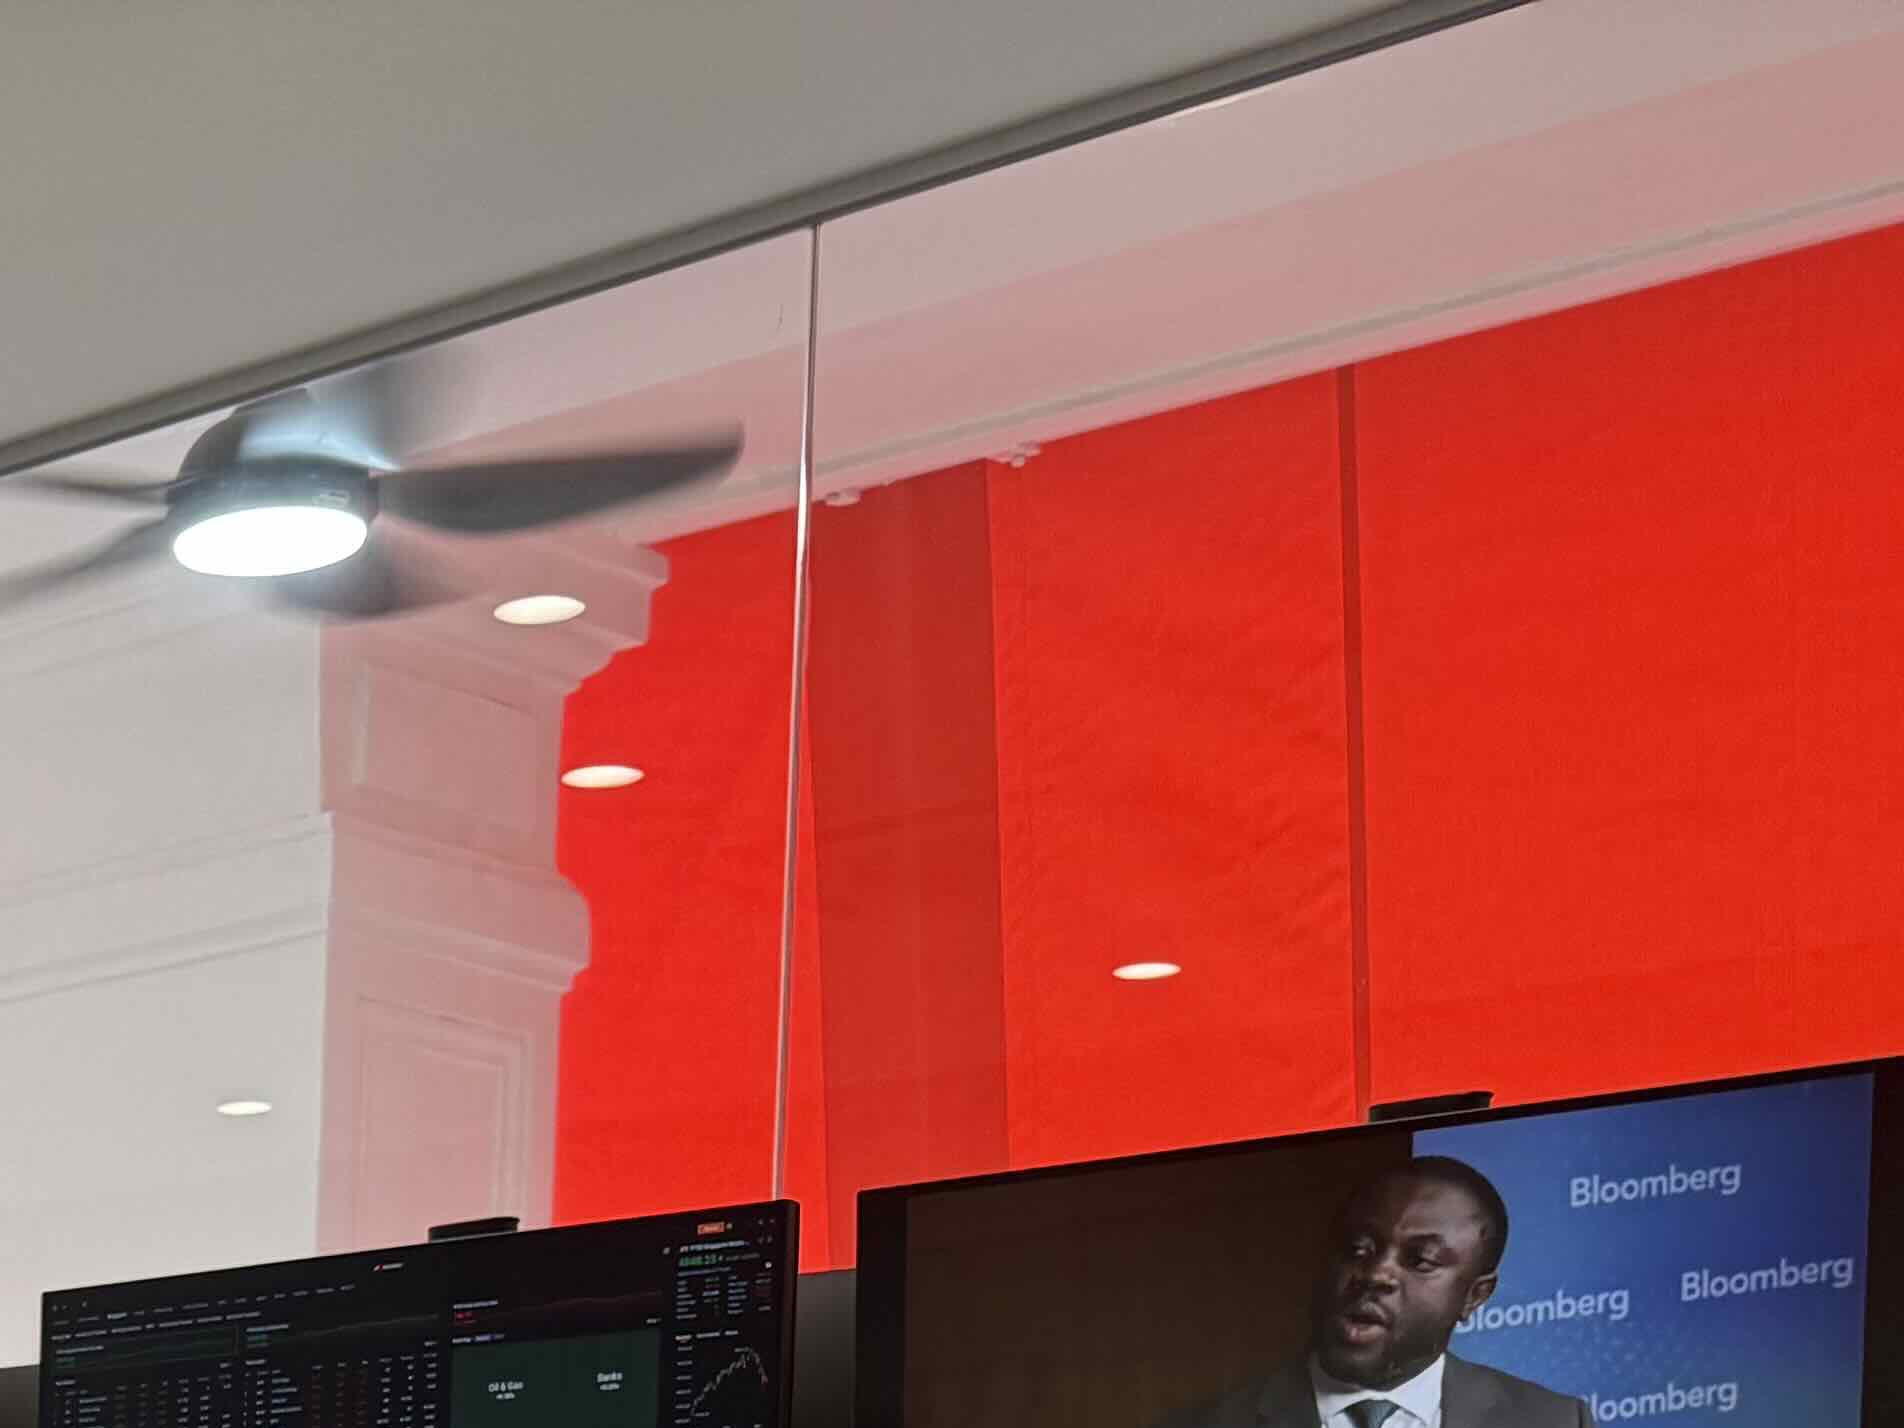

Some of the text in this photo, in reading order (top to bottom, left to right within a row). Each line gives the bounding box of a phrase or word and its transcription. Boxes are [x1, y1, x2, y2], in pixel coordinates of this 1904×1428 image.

[1570, 1163, 1742, 1208] Bloomberg
[1681, 1256, 1854, 1302] Bloomberg
[1582, 1380, 1739, 1422] loomberg
